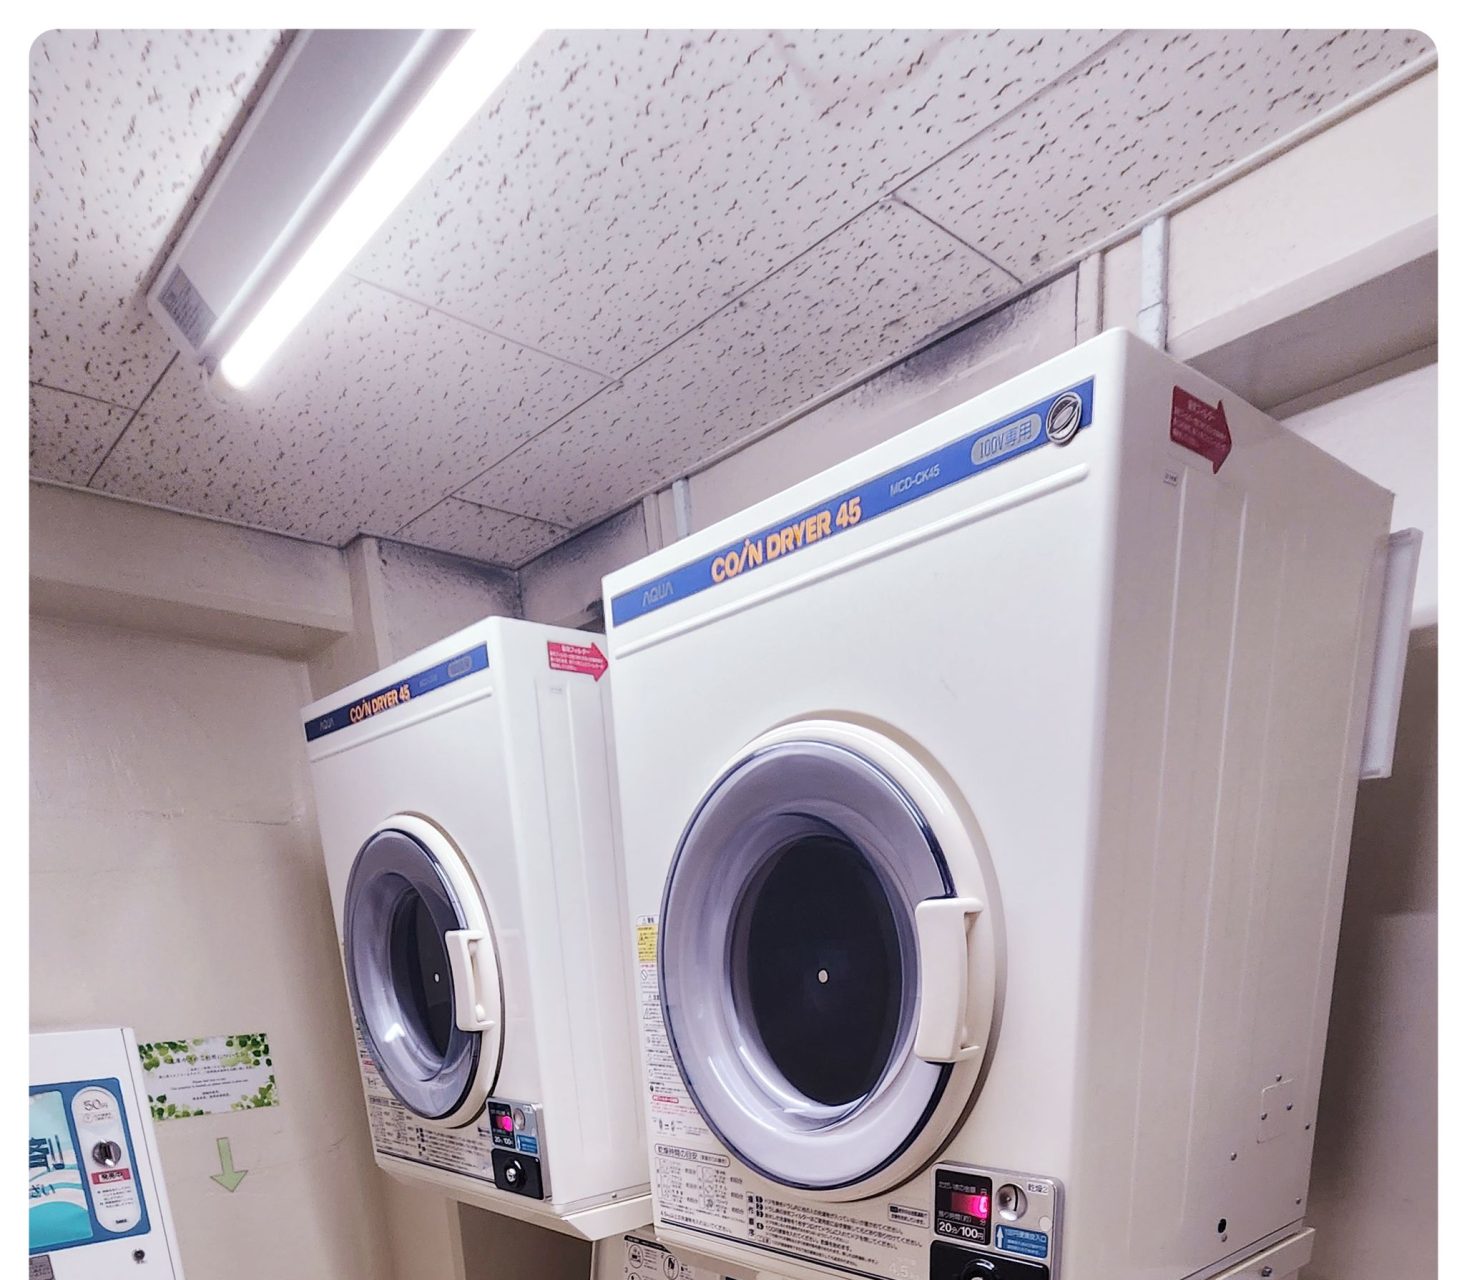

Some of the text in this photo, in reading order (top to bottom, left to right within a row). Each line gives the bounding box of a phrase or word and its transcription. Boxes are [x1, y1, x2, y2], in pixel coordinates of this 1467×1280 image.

[979, 420, 1032, 459] 100V専用
[889, 463, 941, 497] MCD-CK45
[711, 496, 862, 583] COIN DRYER 45
[641, 581, 674, 607] AQUA
[350, 683, 411, 723] COIN DRYER 45
